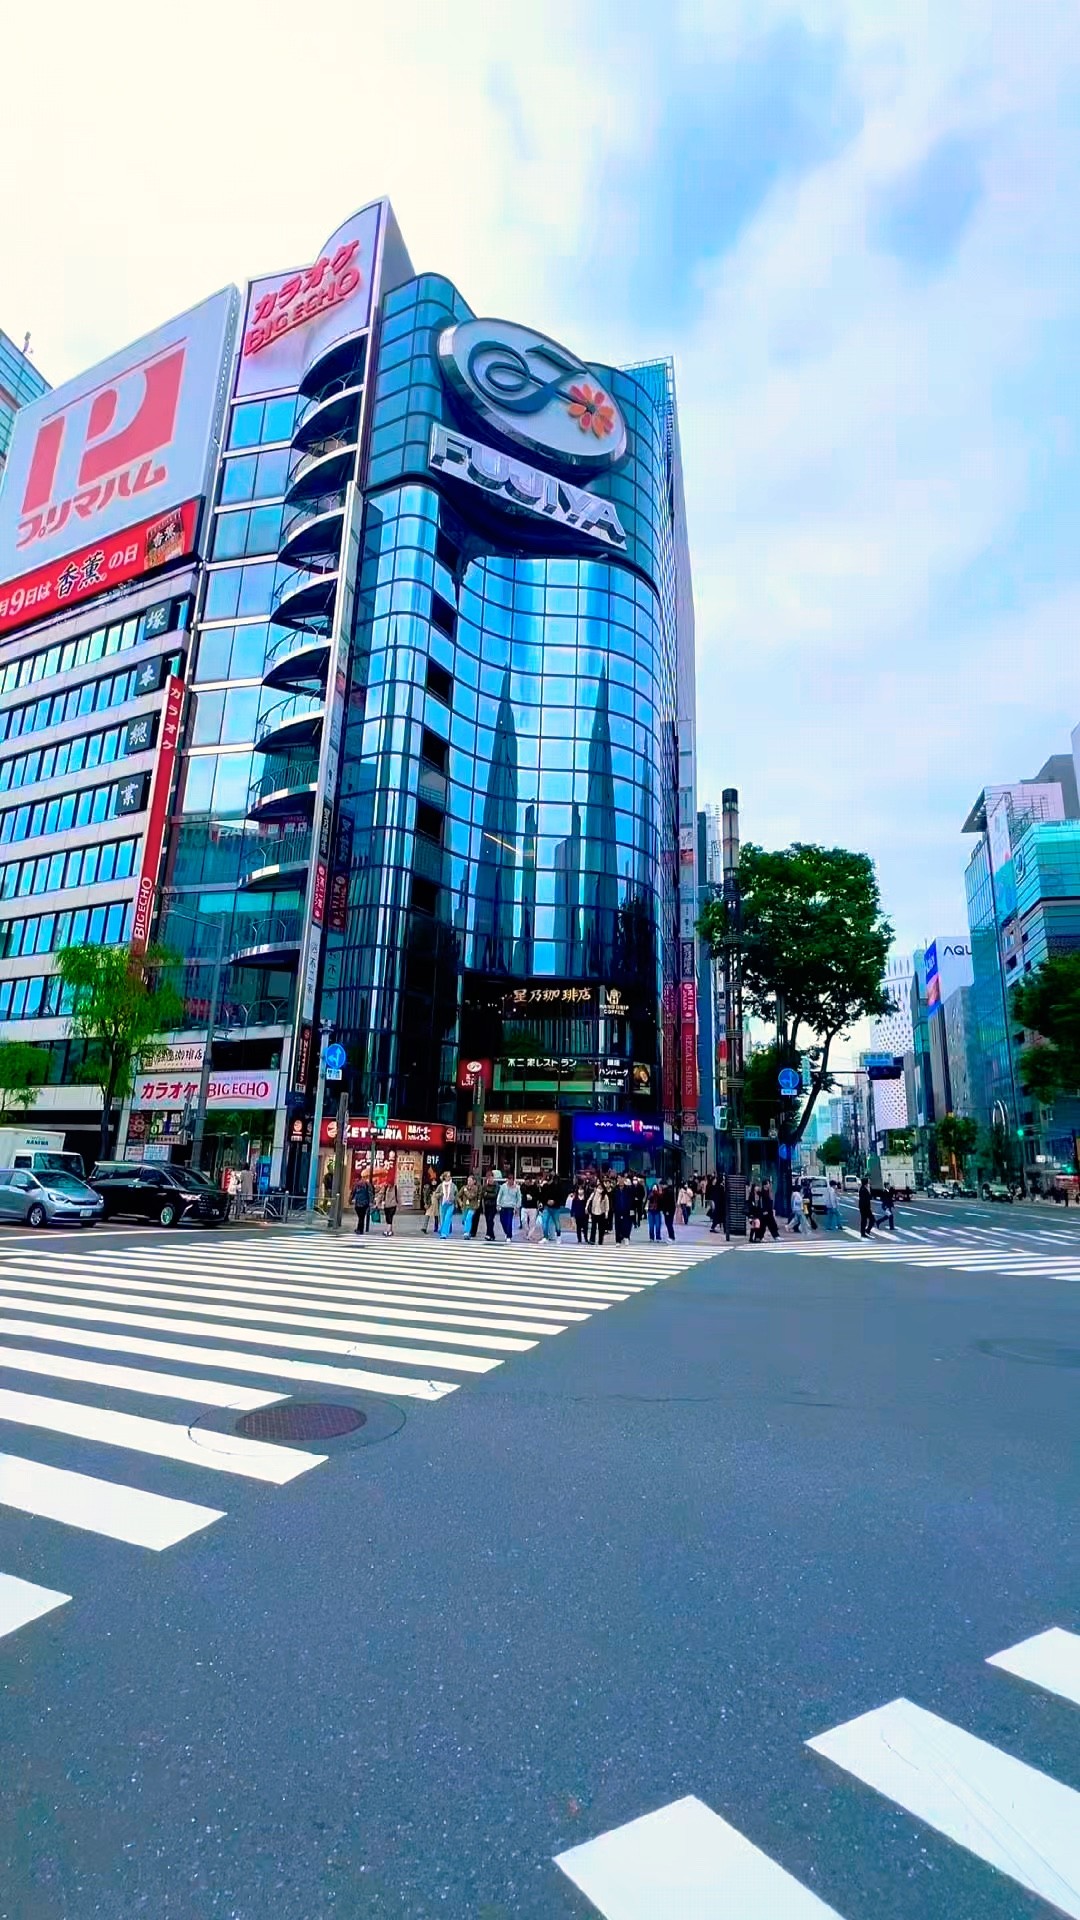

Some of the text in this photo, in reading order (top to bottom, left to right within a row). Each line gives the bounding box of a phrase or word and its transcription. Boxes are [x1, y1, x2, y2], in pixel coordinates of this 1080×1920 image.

[244, 266, 361, 354] BIG ECHO
[252, 239, 360, 326] カラオケ
[16, 459, 167, 550] プリマハム
[428, 421, 627, 550] FUJIYA
[138, 663, 156, 687] 本
[161, 686, 182, 750] カラオケ
[133, 876, 153, 940] BIG ECHO
[512, 987, 592, 1004] 星乃珈琲店
[141, 1081, 198, 1100] カラオケ
[208, 1081, 269, 1098] BIG ECHO
